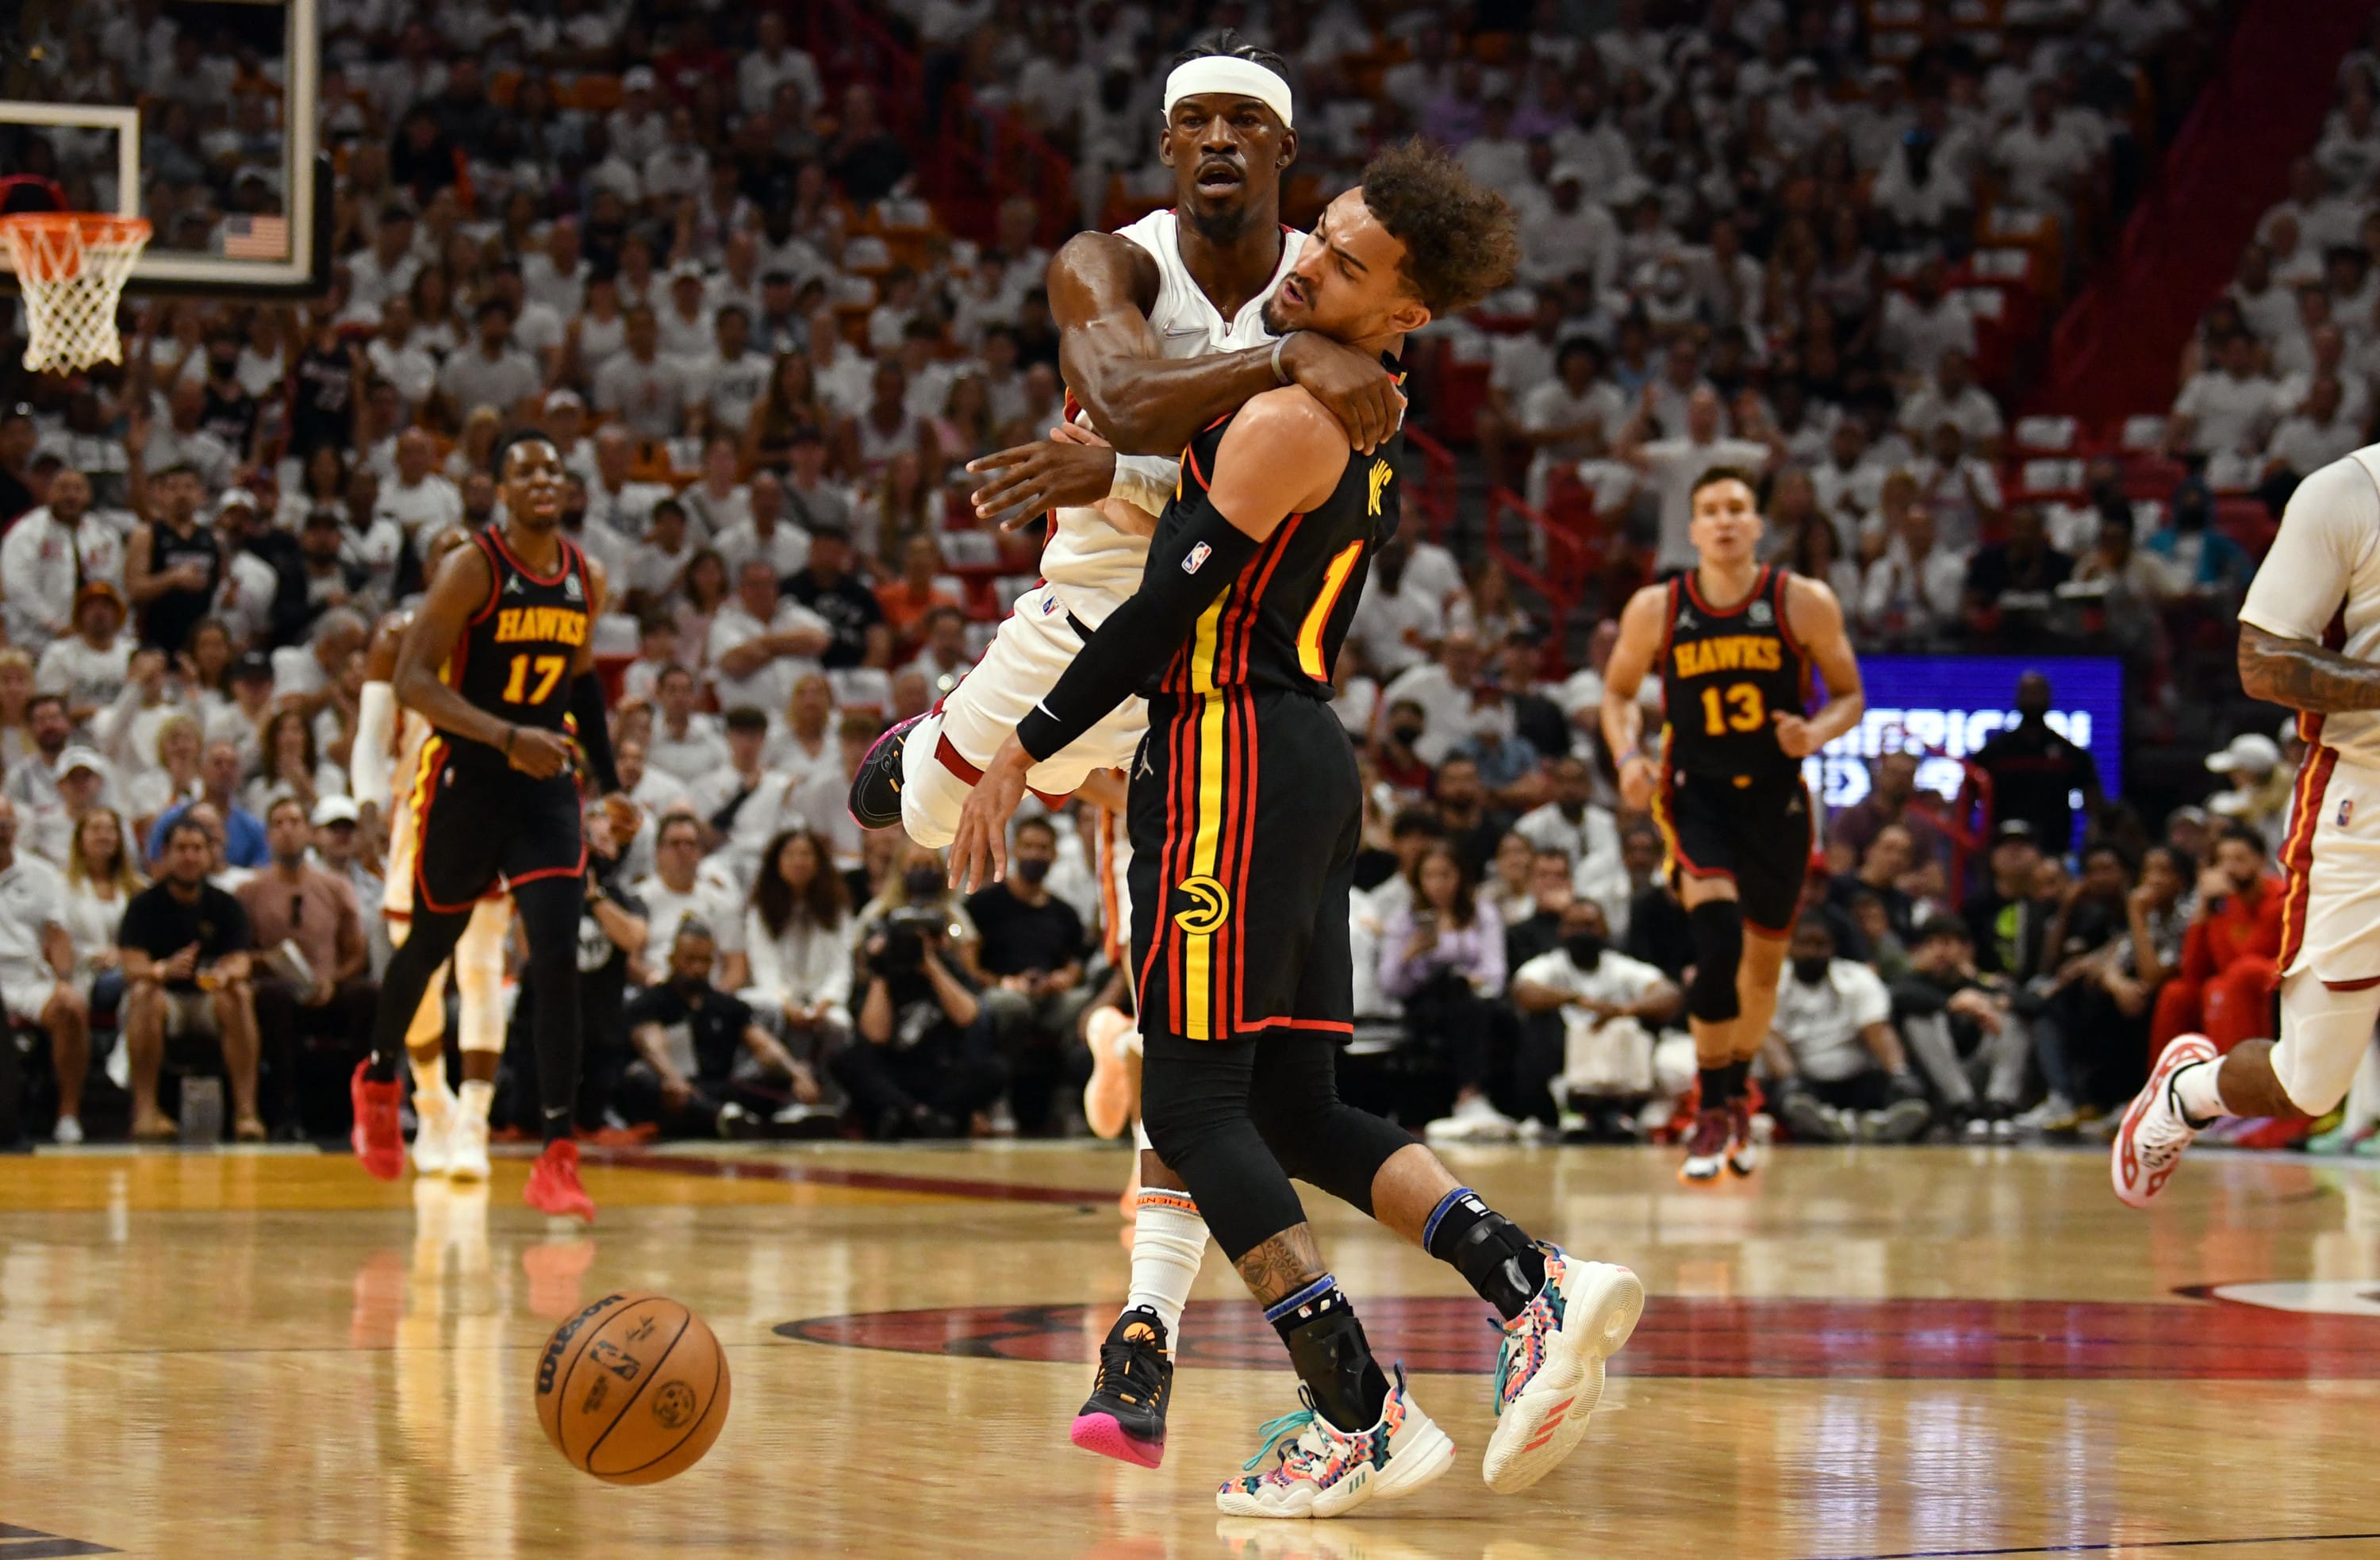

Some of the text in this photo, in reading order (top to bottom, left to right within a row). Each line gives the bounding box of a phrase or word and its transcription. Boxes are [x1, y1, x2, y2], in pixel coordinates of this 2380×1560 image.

[493, 605, 588, 647] HAWKS
[1295, 540, 1364, 682] 1
[502, 653, 566, 705] 17
[1673, 635, 1782, 678] HAWKS
[1701, 682, 1765, 736] 13
